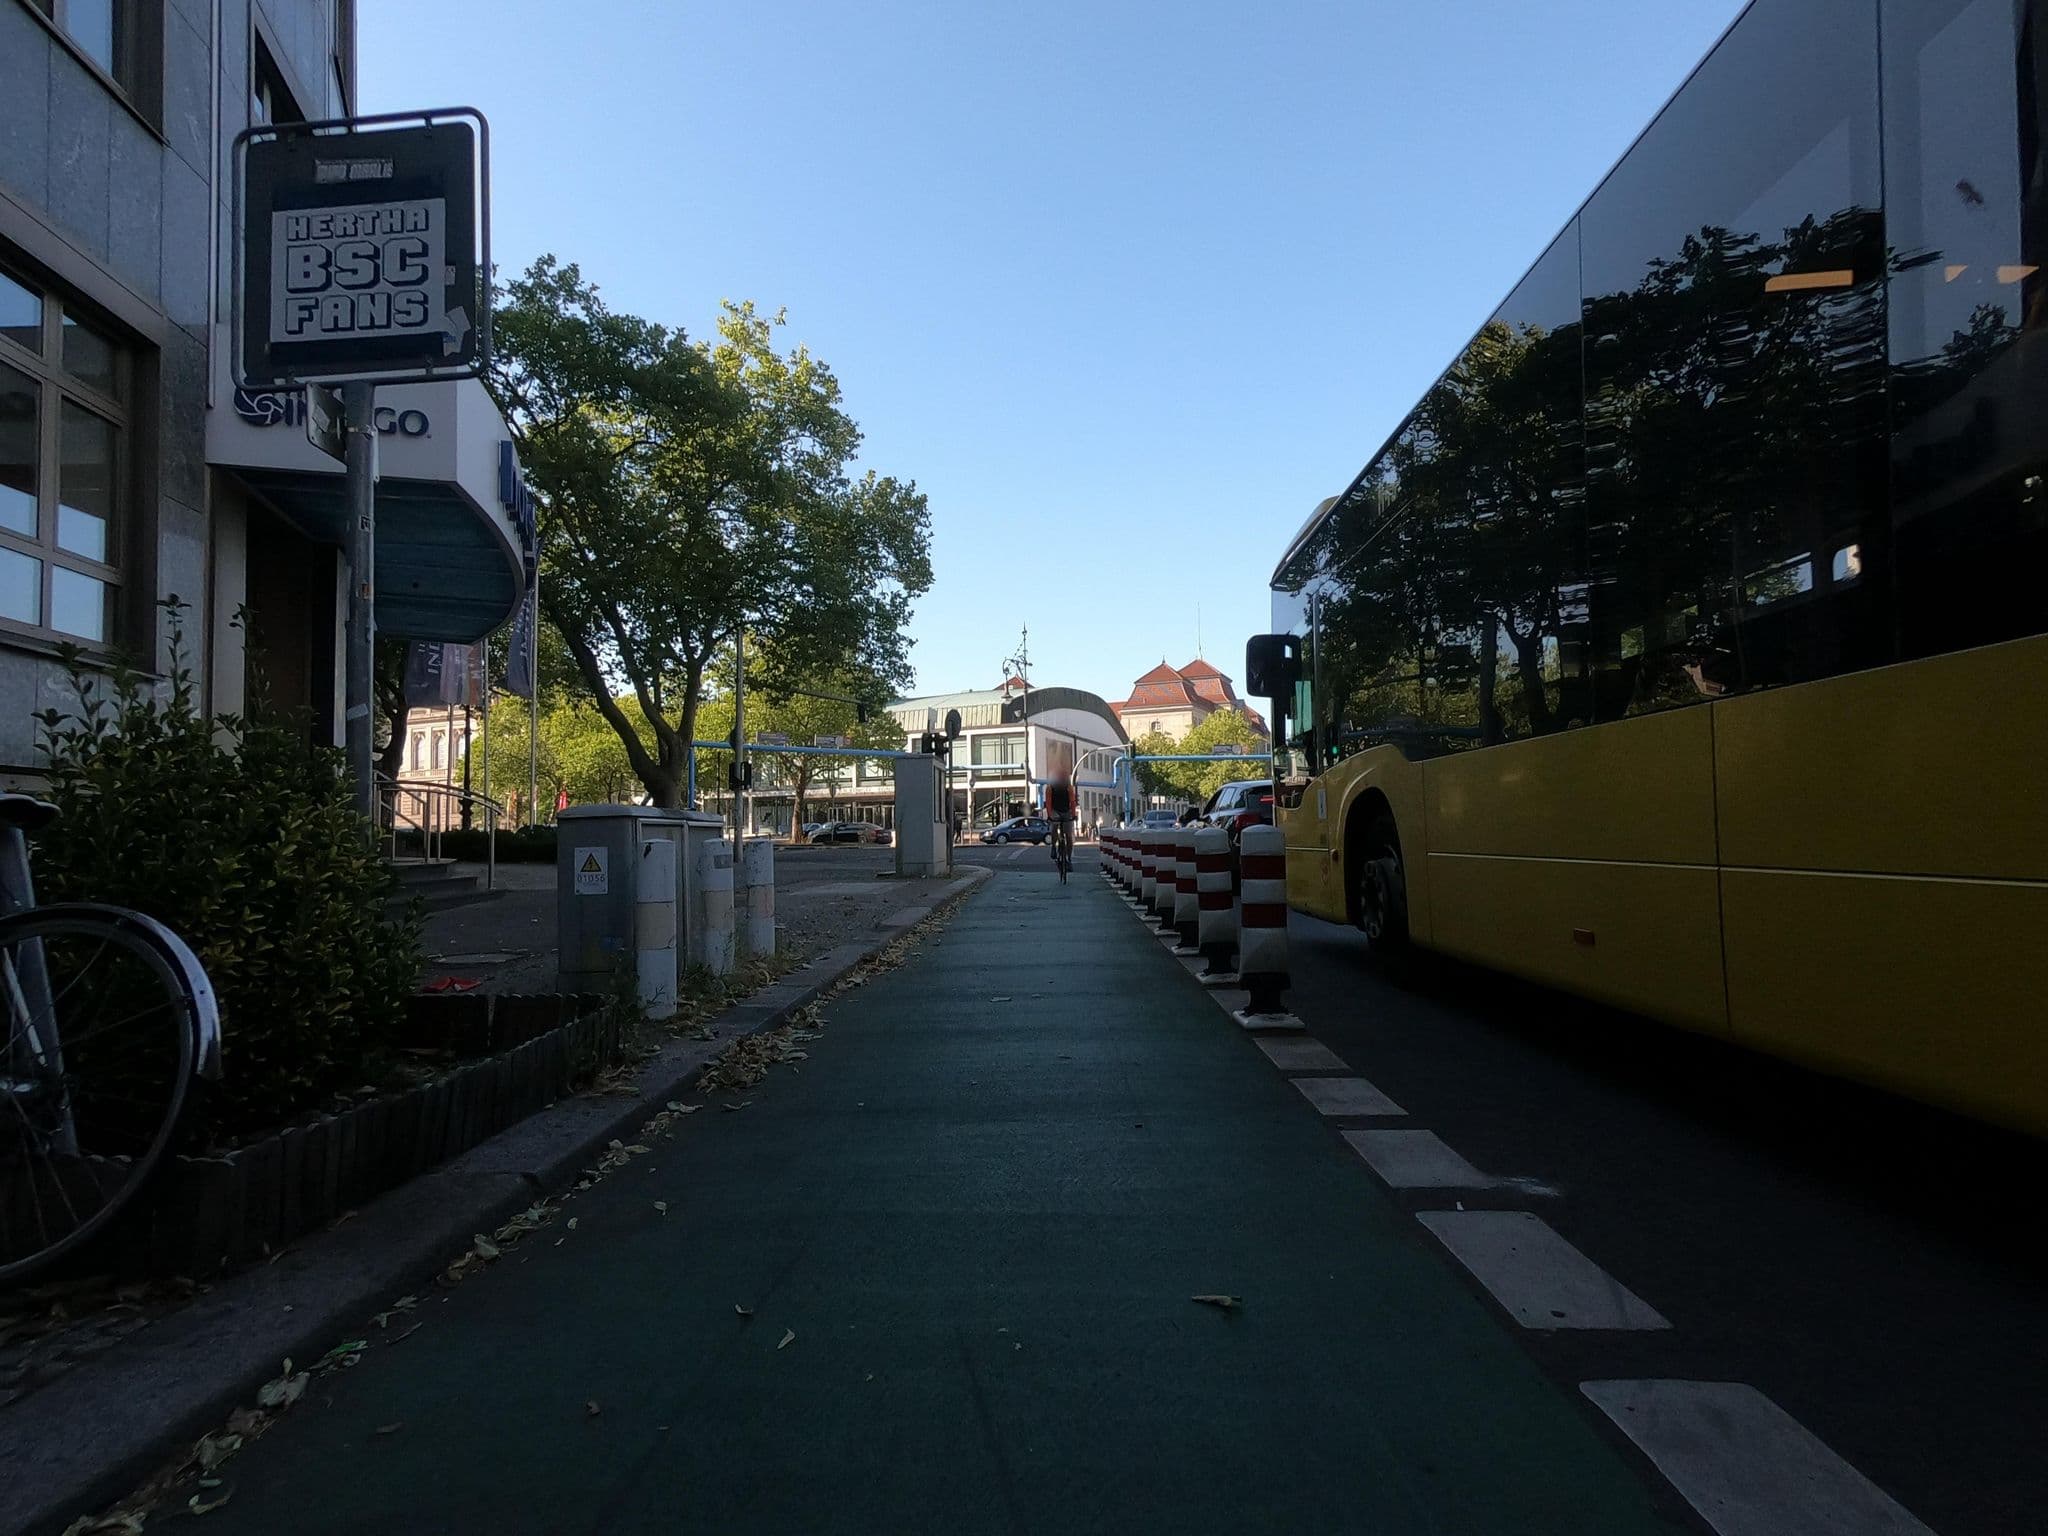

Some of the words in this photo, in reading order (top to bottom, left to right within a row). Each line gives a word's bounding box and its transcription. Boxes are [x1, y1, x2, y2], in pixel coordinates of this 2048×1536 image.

[286, 208, 430, 241] HERTHA
[286, 237, 430, 293] BSC
[285, 290, 430, 335] FANS
